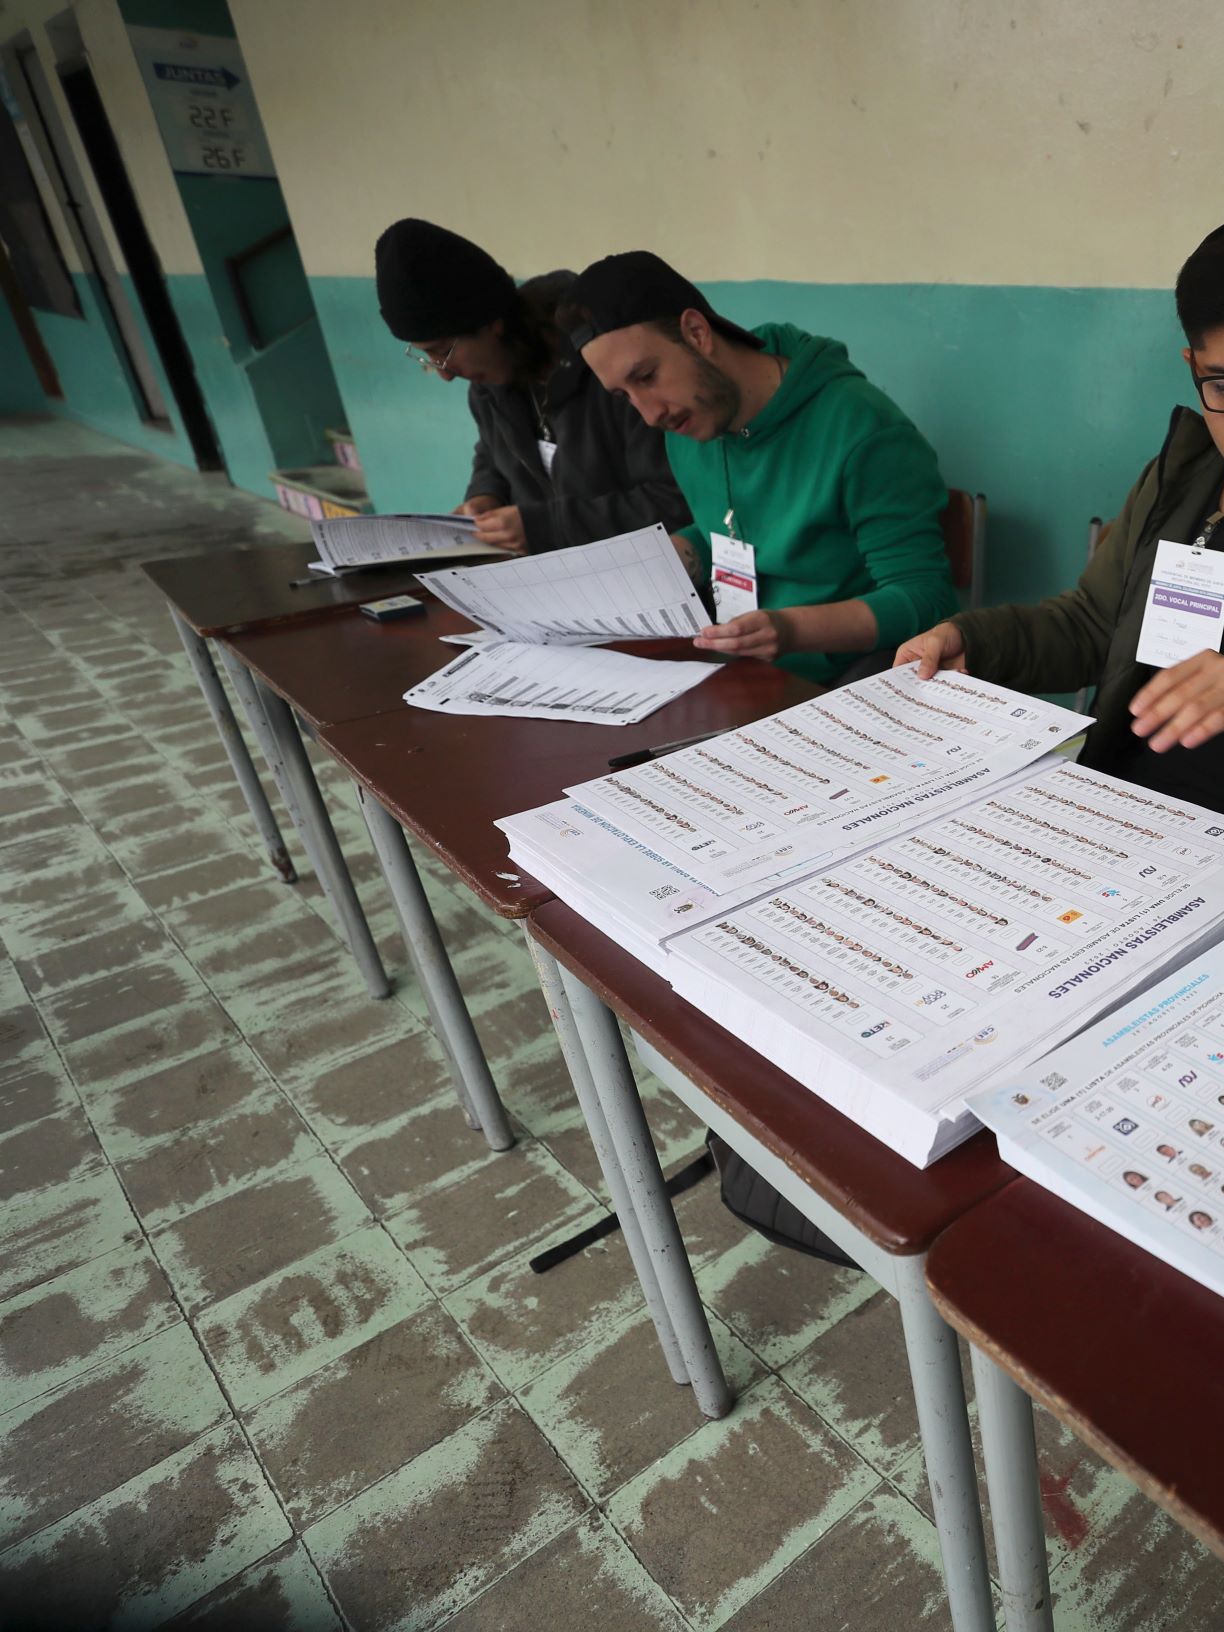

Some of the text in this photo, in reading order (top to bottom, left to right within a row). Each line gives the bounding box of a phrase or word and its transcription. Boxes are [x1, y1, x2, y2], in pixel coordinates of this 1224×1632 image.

[1169, 596, 1188, 606] VOCAL
[1189, 601, 1219, 613] PRINCIPAL
[840, 767, 993, 831] ASAMBLEISTAS NACIONALES
[1147, 899, 1166, 909] UNA
[1108, 926, 1122, 934] DE
[1117, 914, 1141, 928] LISTA
[1123, 896, 1208, 949] ASAMBLEISTAS
[1058, 932, 1111, 965] ASAMBLEISTAS
[1011, 962, 1062, 994] NACIONALES
[1046, 947, 1128, 999] NACIONALES
[1099, 973, 1211, 1047] ASAMBLEISTAS PROVINCIALES
[1084, 1075, 1106, 1090] LISTA
